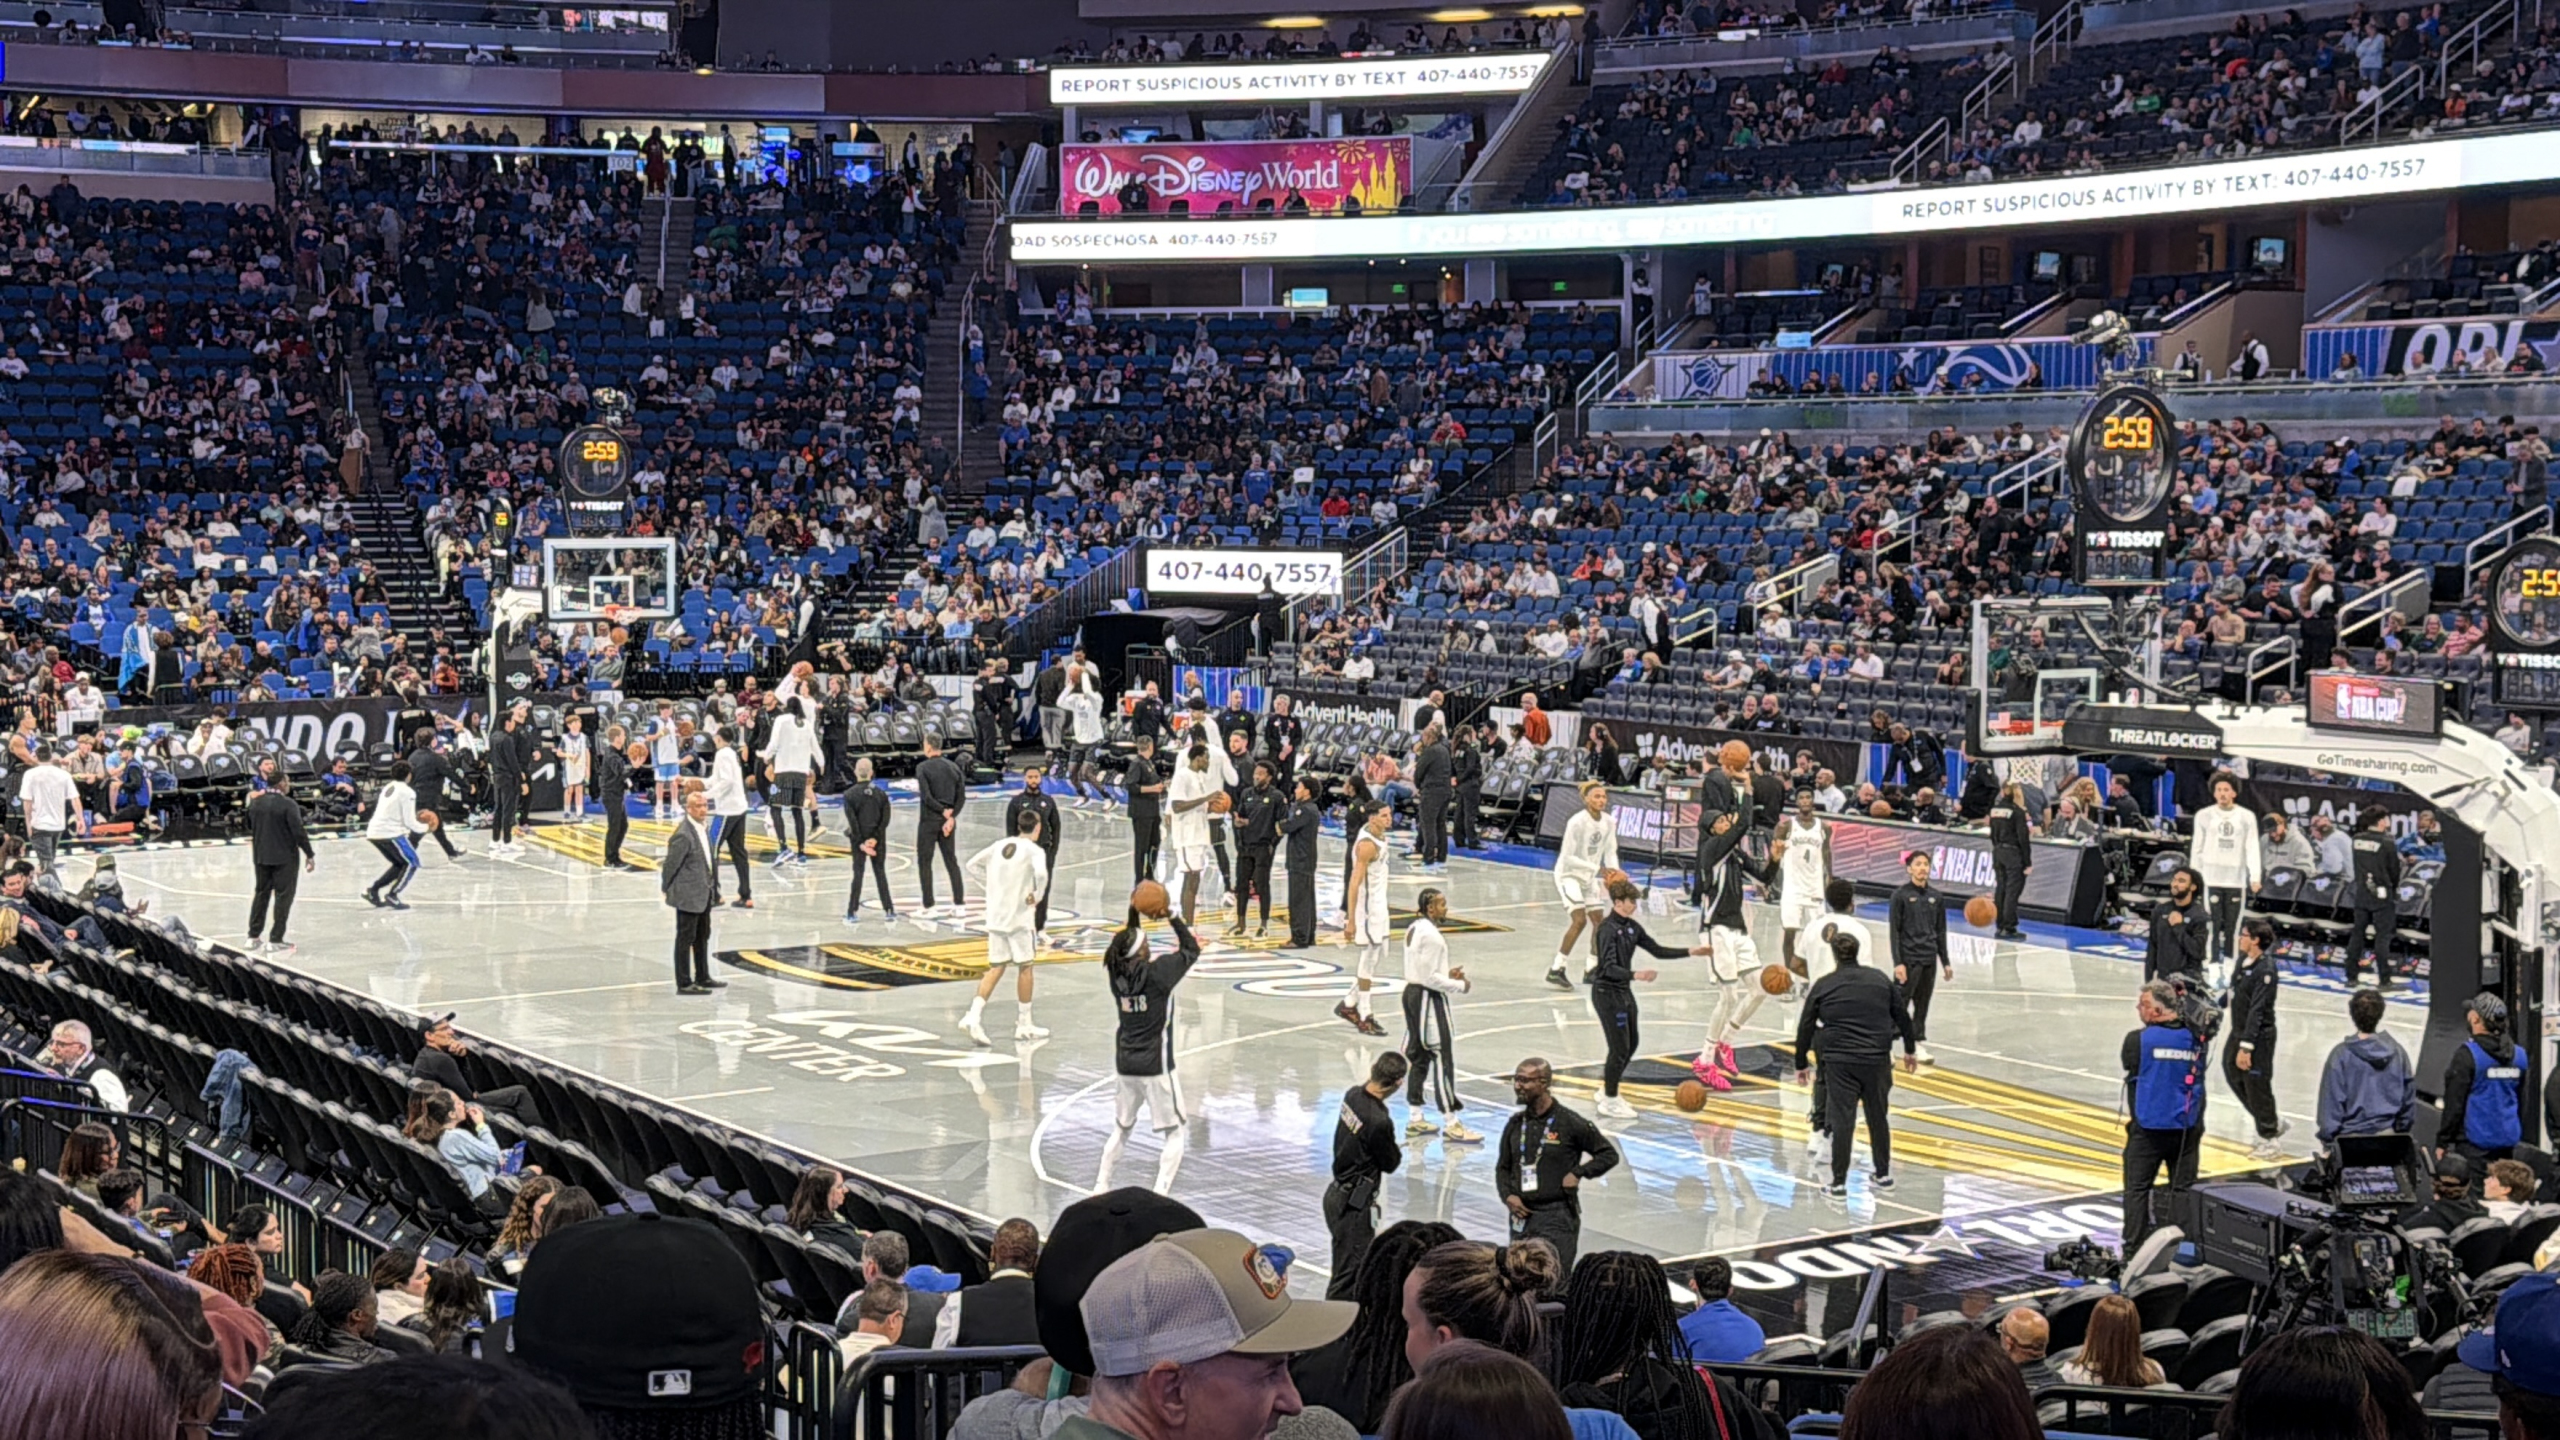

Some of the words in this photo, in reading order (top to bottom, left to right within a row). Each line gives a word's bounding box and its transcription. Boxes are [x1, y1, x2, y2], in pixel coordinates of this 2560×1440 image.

[1061, 78, 1131, 92] REPORT
[1136, 76, 1242, 91] SUSPICIOUS
[1248, 74, 1329, 89] ACTIVITY
[1335, 73, 1356, 87] BY
[1363, 71, 1407, 85] TEXT
[1417, 65, 1538, 83] 407-440-7557
[1261, 159, 1340, 190] World
[1902, 199, 1977, 218] REPORT
[1983, 189, 2096, 213] SUSPICIOUS
[2103, 181, 2186, 203] ACTIVITY
[2193, 178, 2217, 196] BY
[2284, 158, 2426, 186] 407-440-7557
[1051, 233, 1158, 248] SOSPECHOSA
[2103, 415, 2154, 449] 2:59
[583, 440, 620, 461] 2:59
[2108, 531, 2165, 548] TISSOT
[1157, 560, 1332, 583] 407-4407557
[2521, 568, 2560, 597] 2:5
[1292, 699, 1396, 730] AdventHealth
[2109, 727, 2217, 750] THREATLOCKER
[2316, 753, 2438, 776] GoTimesharing.com
[2318, 799, 2418, 840] Adnt
[1942, 846, 1976, 884] NBA
[1974, 850, 1997, 888] CU
[678, 1019, 907, 1082] CENTER
